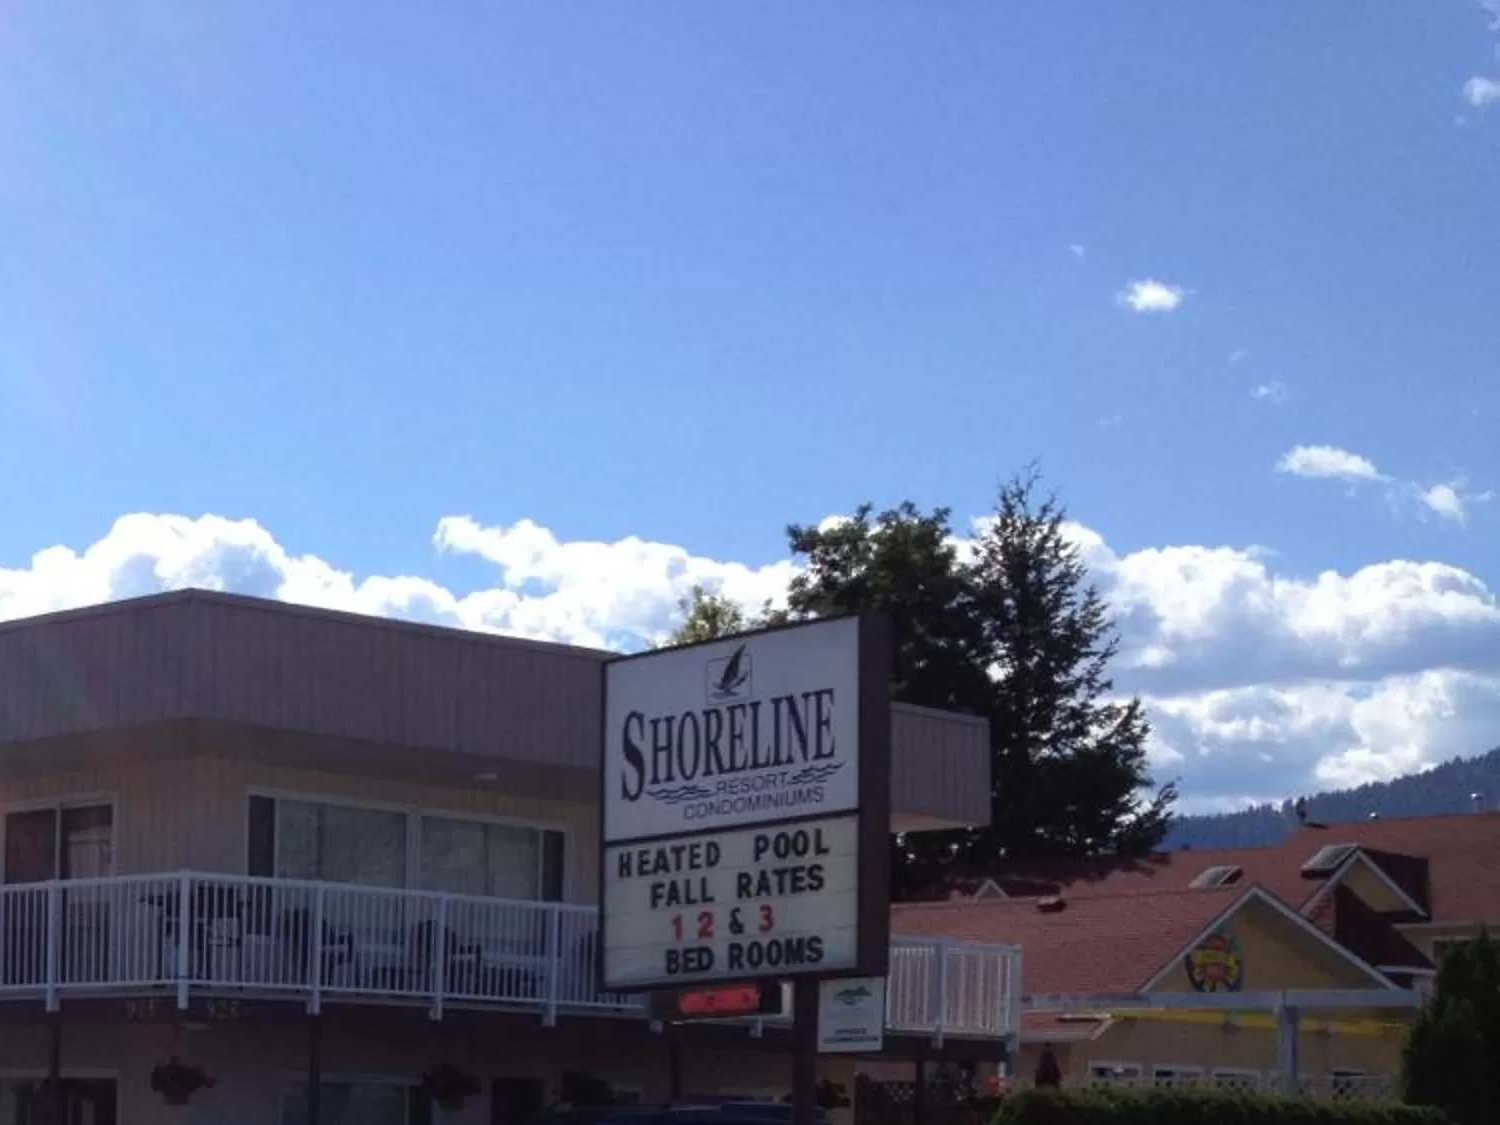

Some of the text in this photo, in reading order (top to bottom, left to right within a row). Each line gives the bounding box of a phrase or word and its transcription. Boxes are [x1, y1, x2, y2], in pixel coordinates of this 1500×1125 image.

[621, 688, 835, 802] SHORELINE
[683, 786, 824, 820] CONDOMINIUMS
[716, 772, 788, 795] RESORT
[618, 828, 829, 878] HEATED POOL
[650, 864, 825, 909] FALL RATES
[671, 904, 774, 940] 1 2 & 3
[665, 935, 824, 974] BED ROOMS
